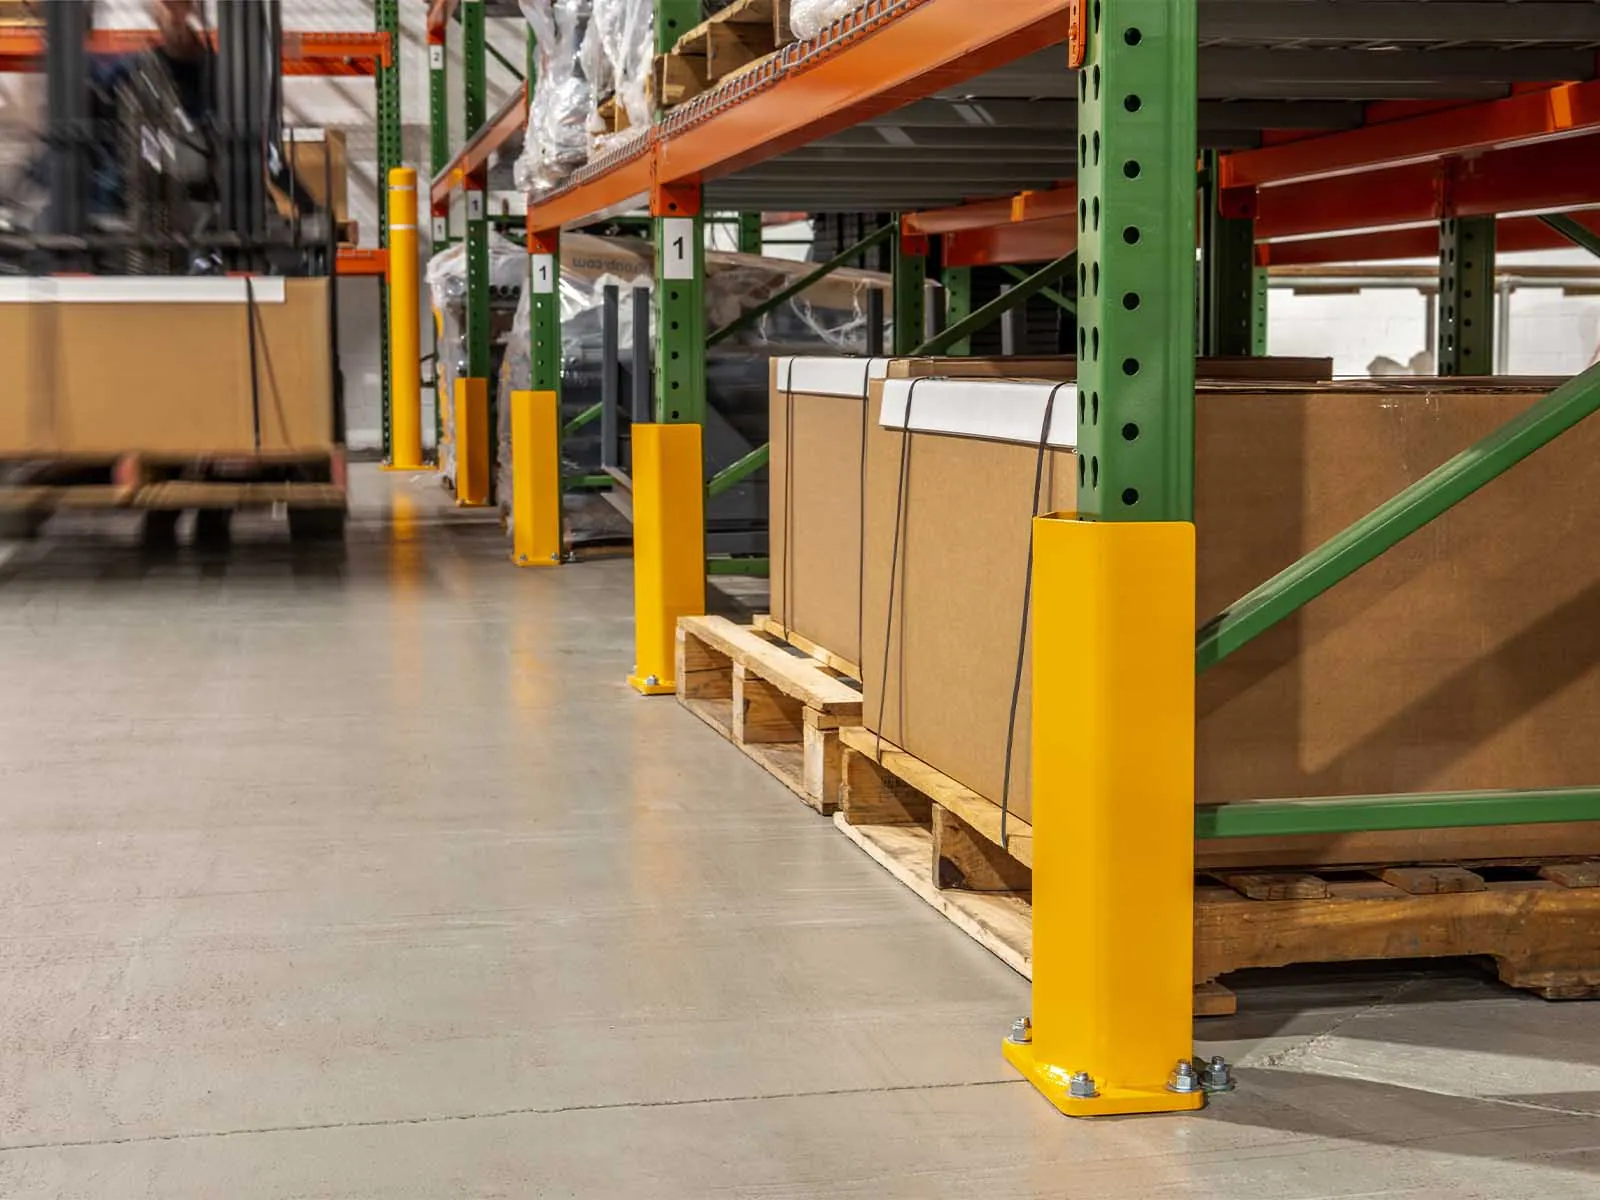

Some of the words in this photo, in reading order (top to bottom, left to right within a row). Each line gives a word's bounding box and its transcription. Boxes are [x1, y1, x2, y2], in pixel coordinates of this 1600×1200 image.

[472, 200, 478, 211] 1
[673, 236, 683, 259] 1
[539, 265, 546, 280] 1
